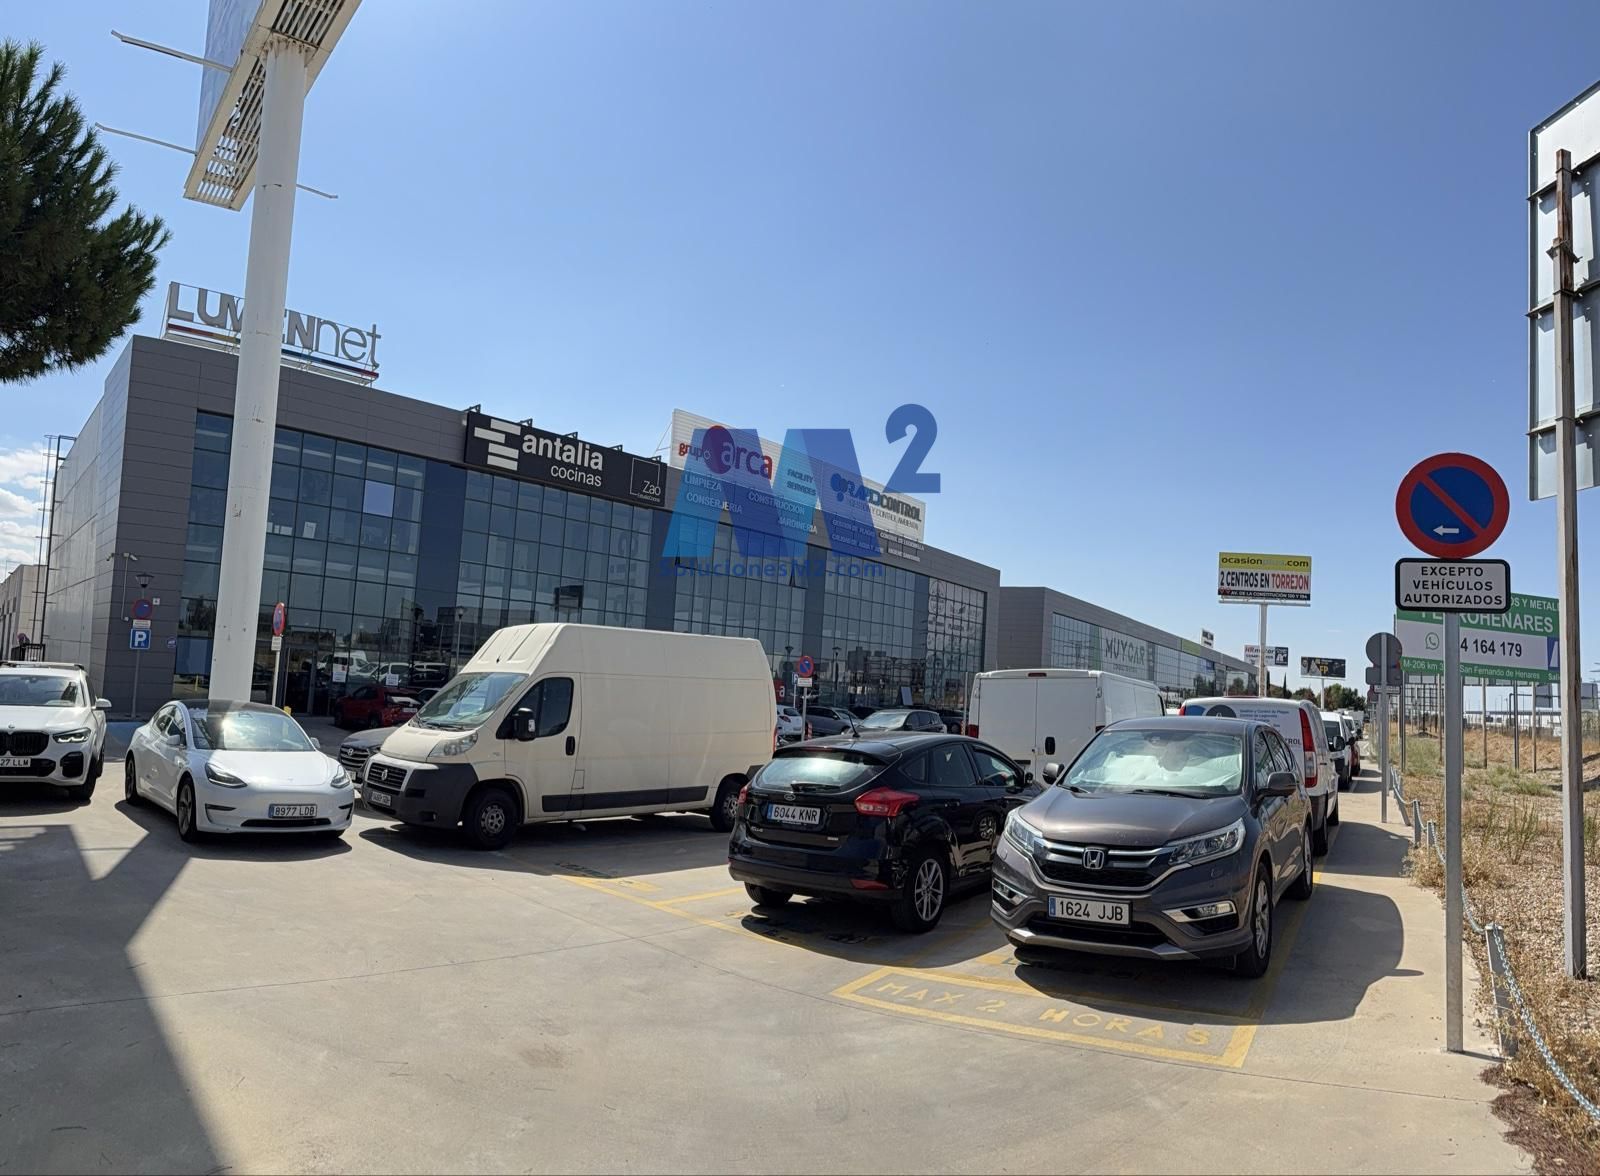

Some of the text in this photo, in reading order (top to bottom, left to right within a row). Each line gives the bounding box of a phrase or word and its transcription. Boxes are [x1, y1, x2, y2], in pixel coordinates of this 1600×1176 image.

[168, 281, 381, 369] LUMNnet
[522, 433, 603, 471] antalia
[678, 442, 711, 461] grupo
[721, 442, 772, 480] arca
[550, 465, 602, 487] cocinas
[684, 474, 721, 491] LIMPIEZA
[787, 468, 813, 483] FACILITY
[643, 480, 661, 496] Zao
[786, 480, 816, 496] SERVICES
[1421, 566, 1484, 577] EXCEPTO
[1220, 571, 1309, 590] 2 CENTROS EN TORREJON
[1413, 578, 1493, 591] VEHÍCULOS
[1404, 594, 1503, 606] AUTORIZADOS
[1521, 598, 1528, 607] Y
[1105, 637, 1145, 665] MUYCAR
[1473, 638, 1496, 655] 164
[1500, 641, 1522, 657] 179
[1403, 659, 1426, 669] M-206
[1427, 662, 1438, 670] km
[1460, 664, 1472, 674] San
[1474, 666, 1504, 676] Fernando
[1506, 669, 1514, 677] de
[1515, 671, 1540, 680] Henares
[12, 758, 29, 767] LLM
[275, 806, 297, 816] 8977
[773, 806, 818, 822] 6044 KNR
[1060, 901, 1123, 920] 1624 JJB
[876, 981, 1212, 1045] MAX 2 HORAS
